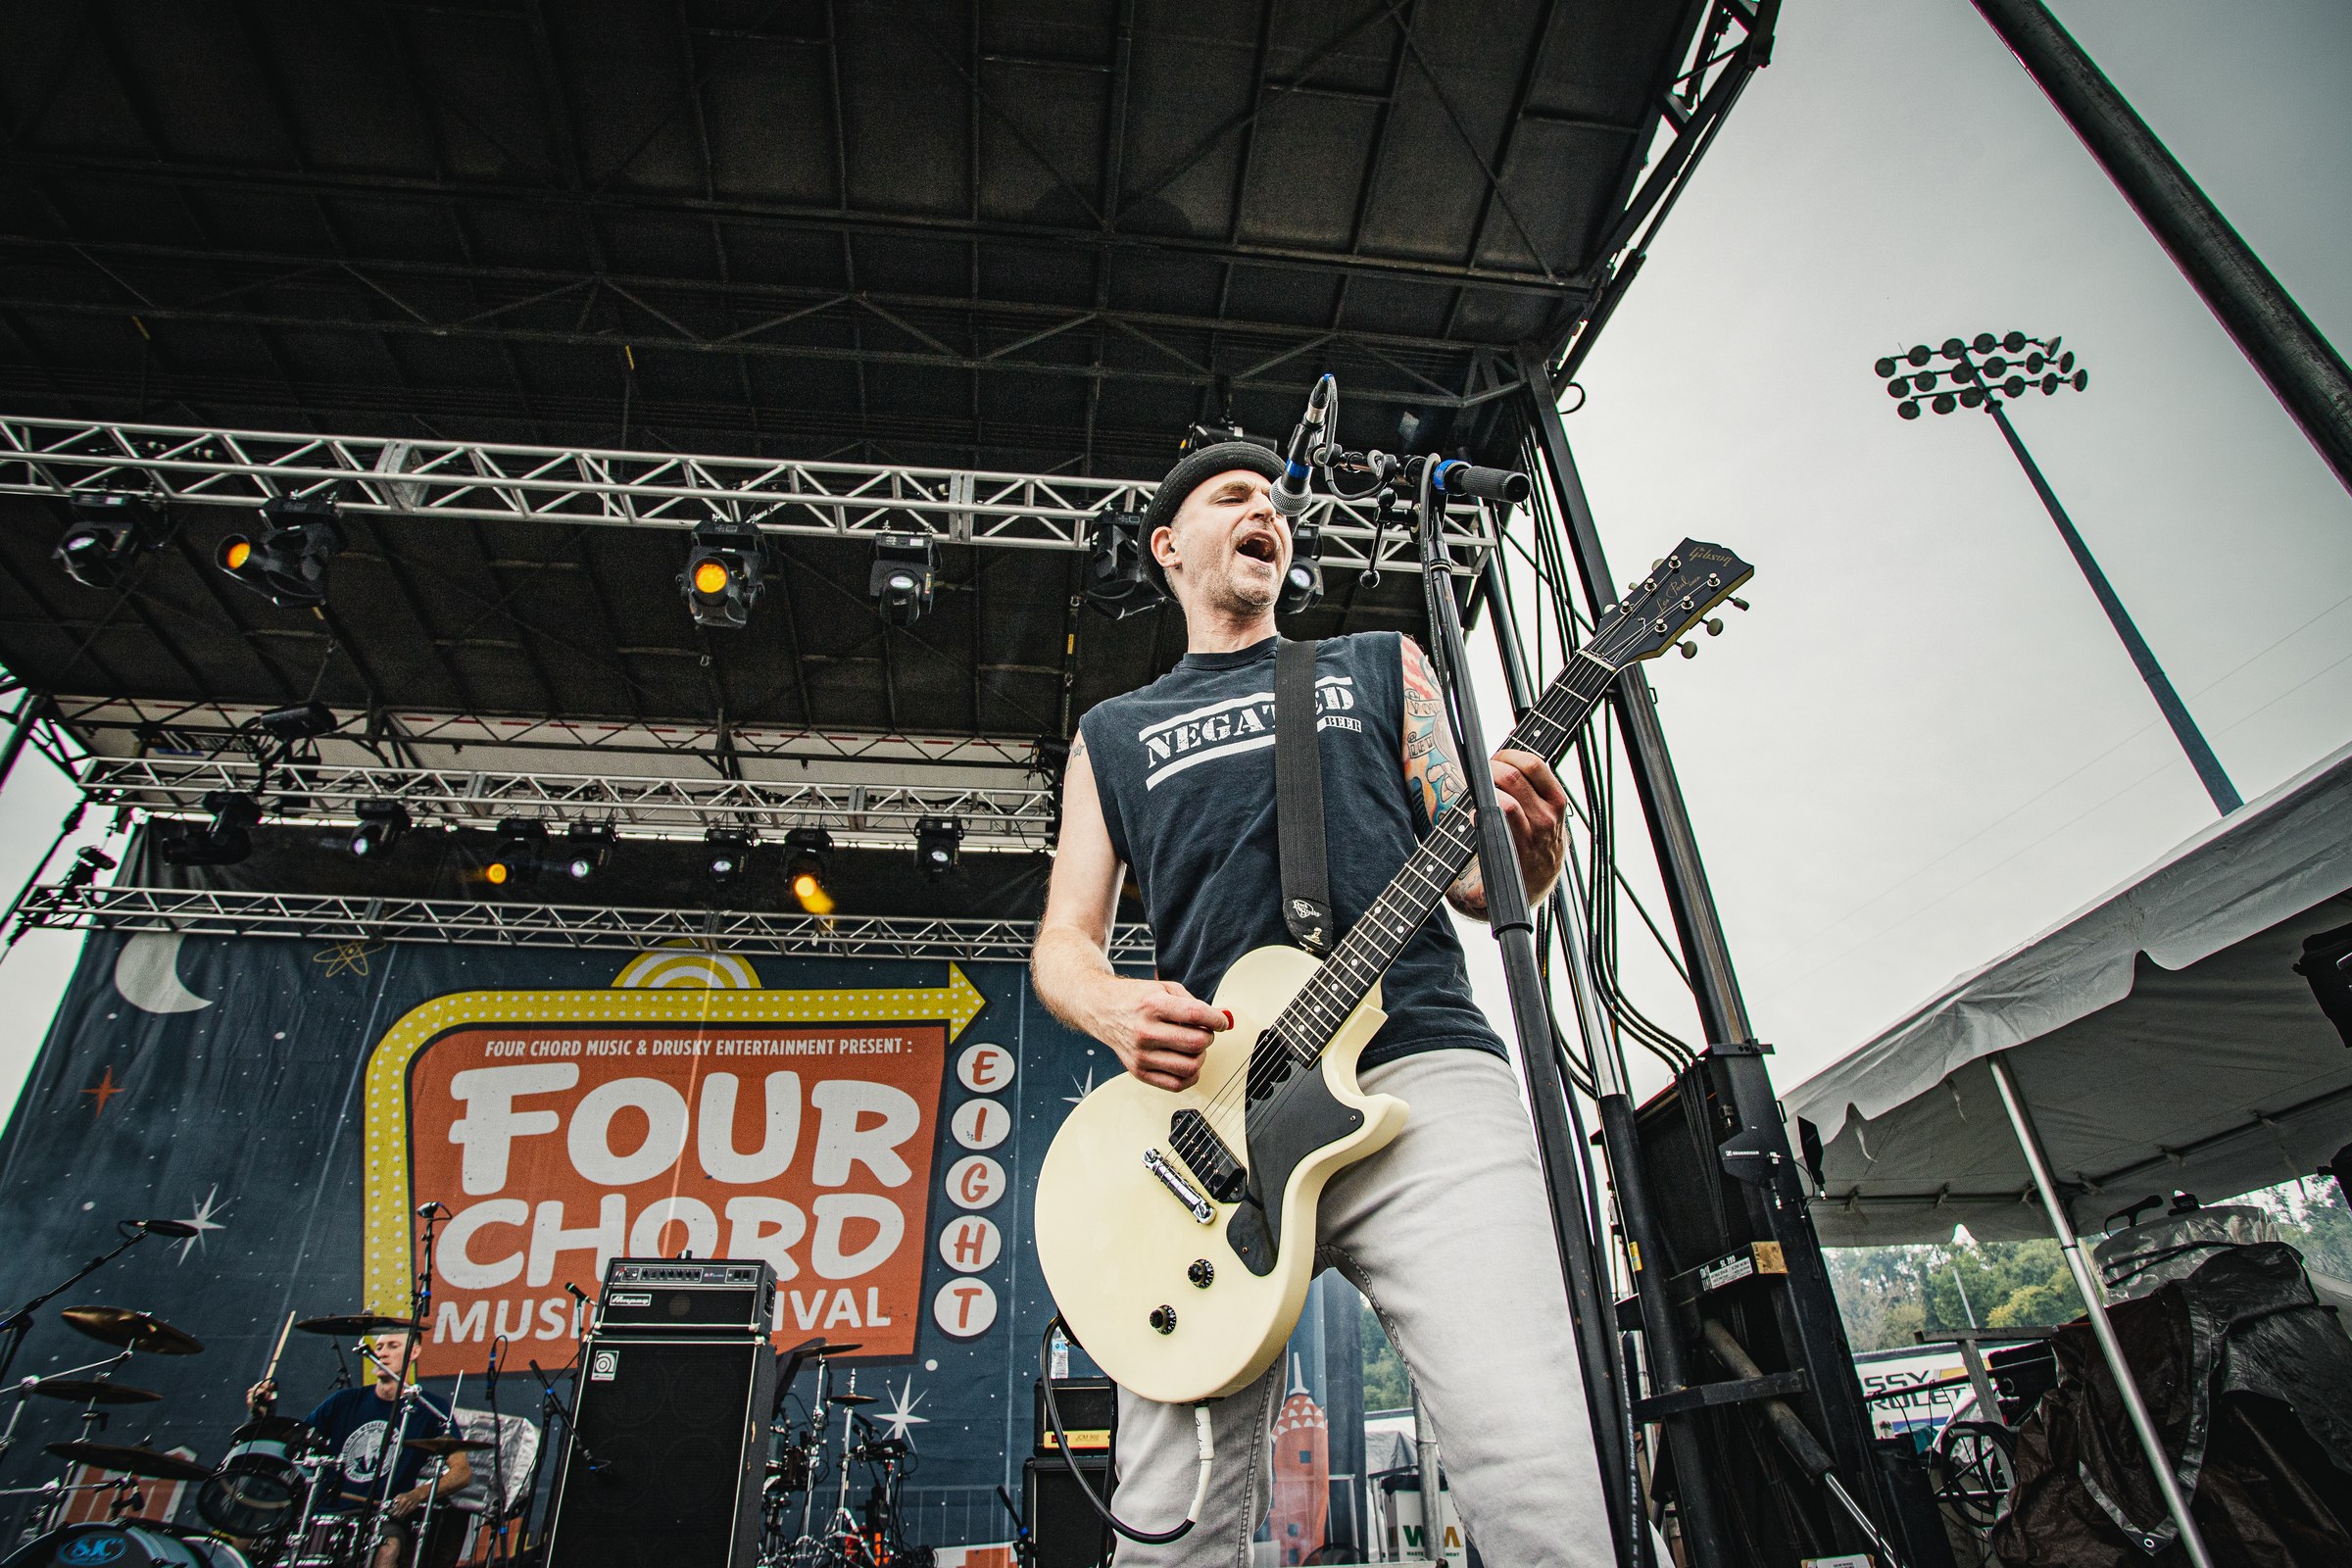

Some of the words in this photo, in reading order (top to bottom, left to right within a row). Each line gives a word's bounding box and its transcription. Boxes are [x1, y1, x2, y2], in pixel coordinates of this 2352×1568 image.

[1689, 546, 1733, 567] Gibson
[1666, 574, 1691, 599] Paul
[1146, 686, 1354, 769] NEGAD
[1324, 716, 1361, 732] BEER
[485, 1040, 526, 1056] FOUR
[529, 1039, 582, 1056] CHORD
[586, 1039, 632, 1056] MUSIC
[636, 1039, 647, 1055] &
[652, 1039, 711, 1055] DRUSKY
[715, 1039, 835, 1055] ENTERTAINMENT
[839, 1037, 903, 1054] PRESENT
[448, 1062, 921, 1196] FOUR
[435, 1193, 906, 1290] CHORD
[433, 1297, 598, 1345] MUSI
[771, 1287, 891, 1332] IVAL
[1864, 1370, 1929, 1394] SSY
[1870, 1387, 1967, 1412] ROLET
[1627, 1412, 1636, 1470] MICROPHONE
